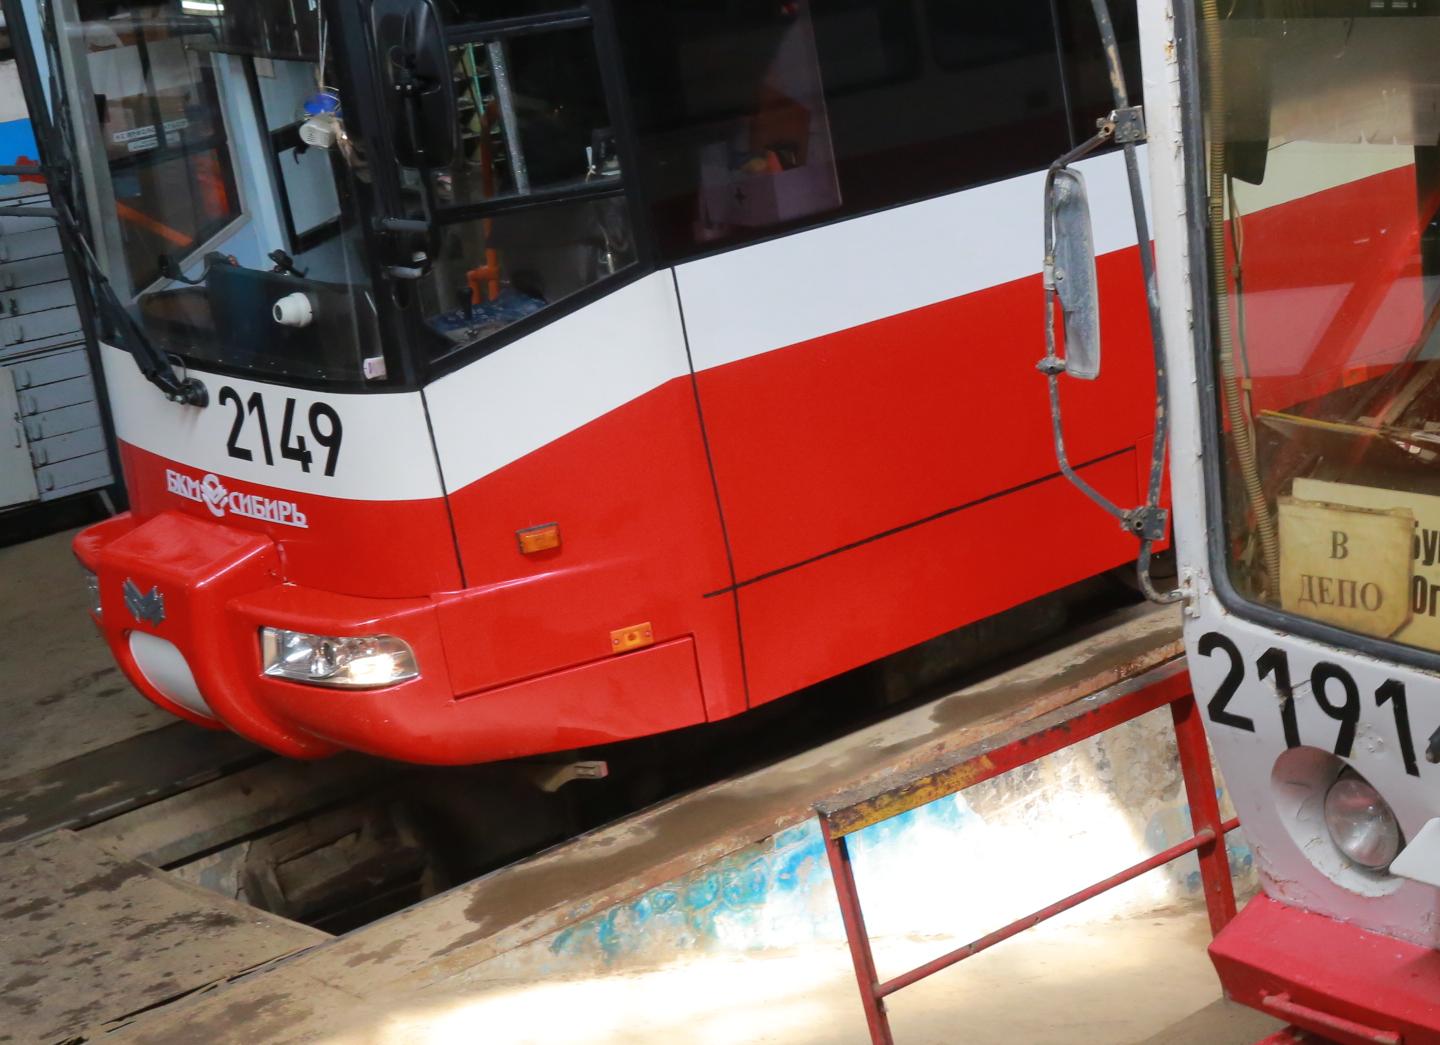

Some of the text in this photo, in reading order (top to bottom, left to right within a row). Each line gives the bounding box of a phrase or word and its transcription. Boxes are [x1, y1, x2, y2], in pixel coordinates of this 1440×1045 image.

[219, 386, 343, 477] 2149
[166, 469, 308, 528] БКМ СИБИРЬ
[1328, 530, 1349, 560] В
[1298, 574, 1383, 612] ДЕПО
[1197, 632, 1420, 777] 2191
